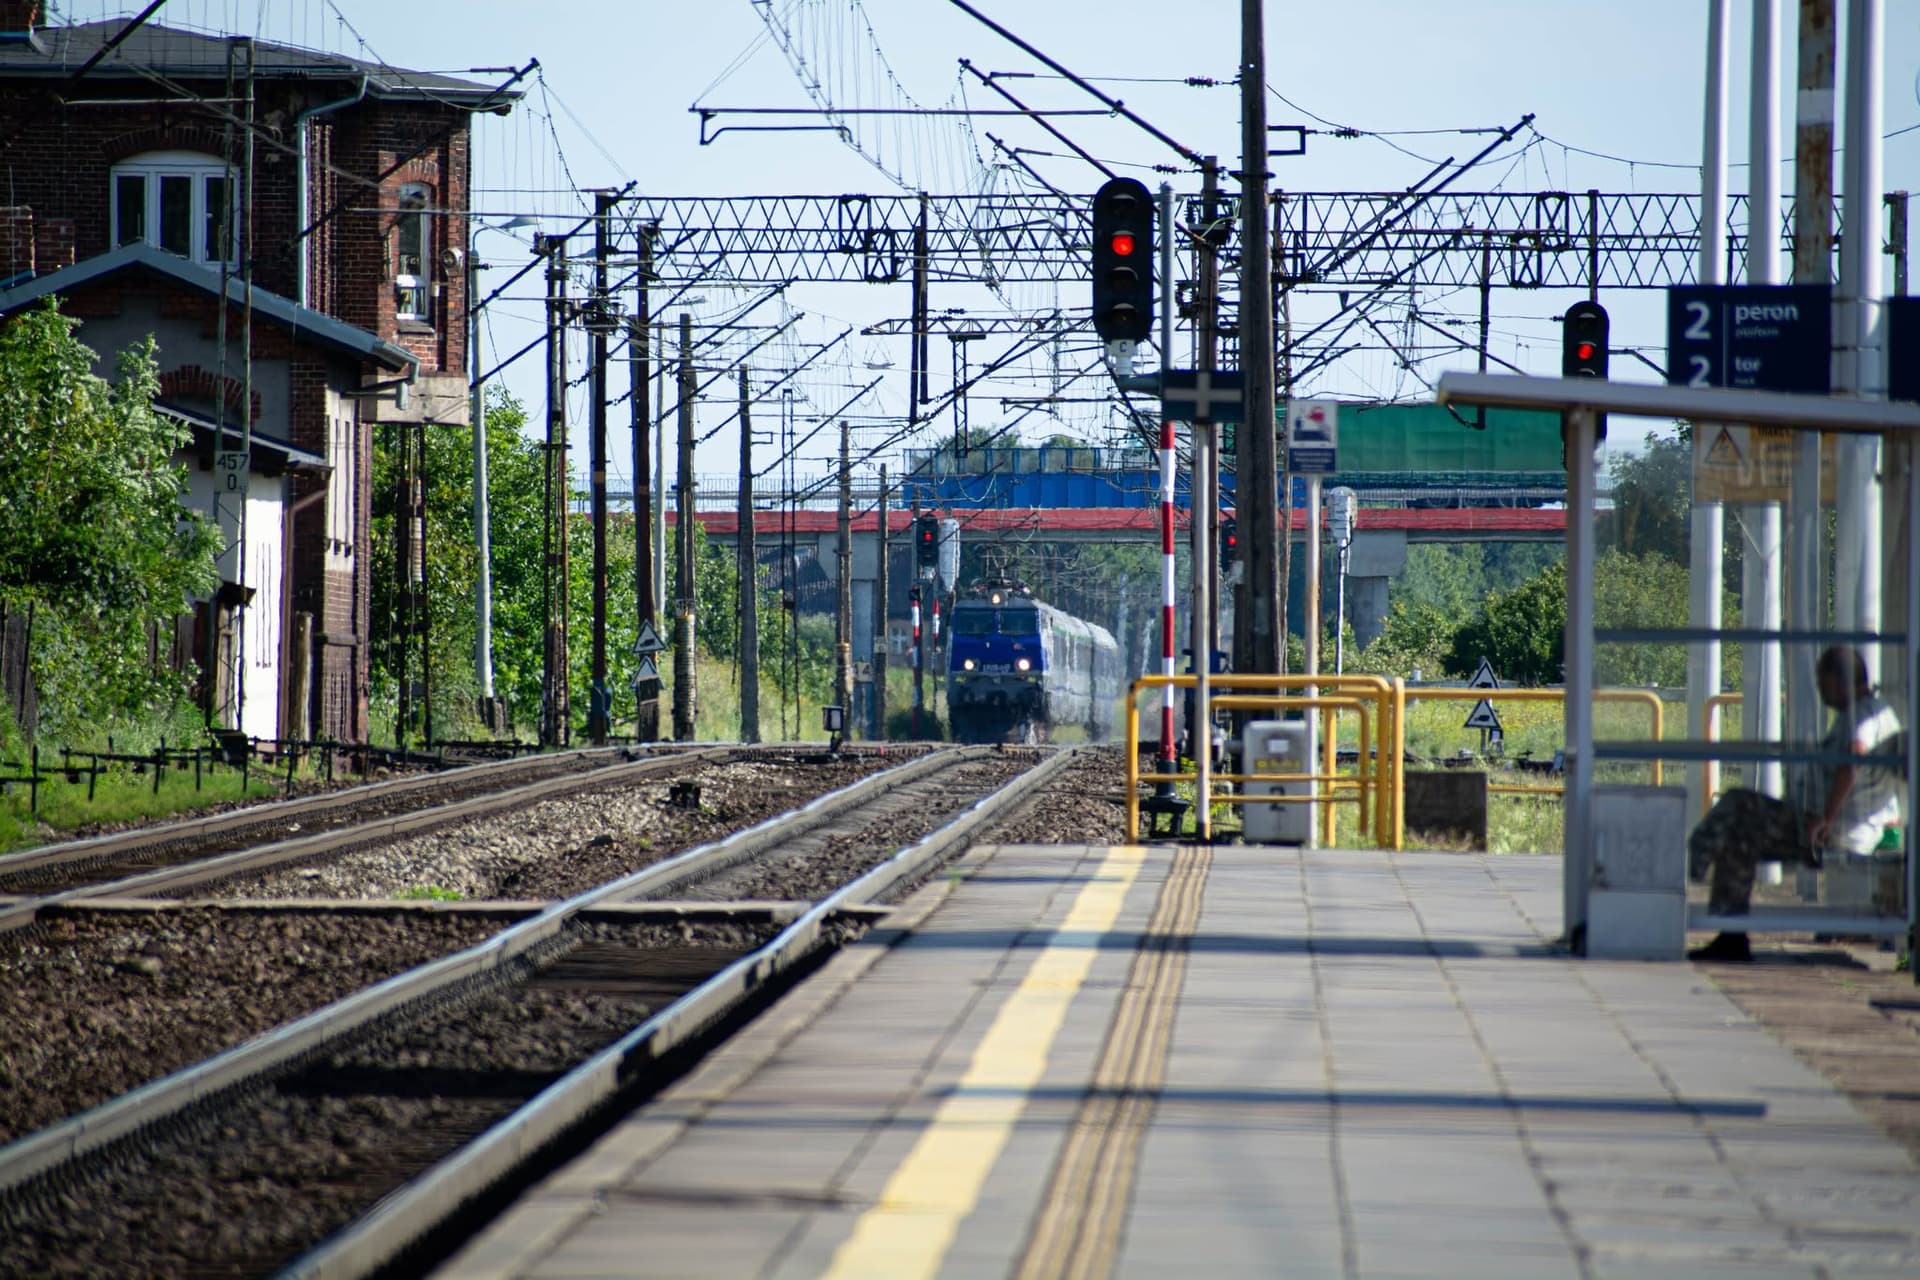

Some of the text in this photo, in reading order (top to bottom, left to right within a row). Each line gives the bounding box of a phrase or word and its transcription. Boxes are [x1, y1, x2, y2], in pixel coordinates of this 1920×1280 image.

[1684, 301, 1799, 339] 2 peron
[1119, 341, 1127, 353] C
[1688, 355, 1761, 388] 2 tor
[216, 454, 248, 470] 457
[228, 474, 237, 490] 0
